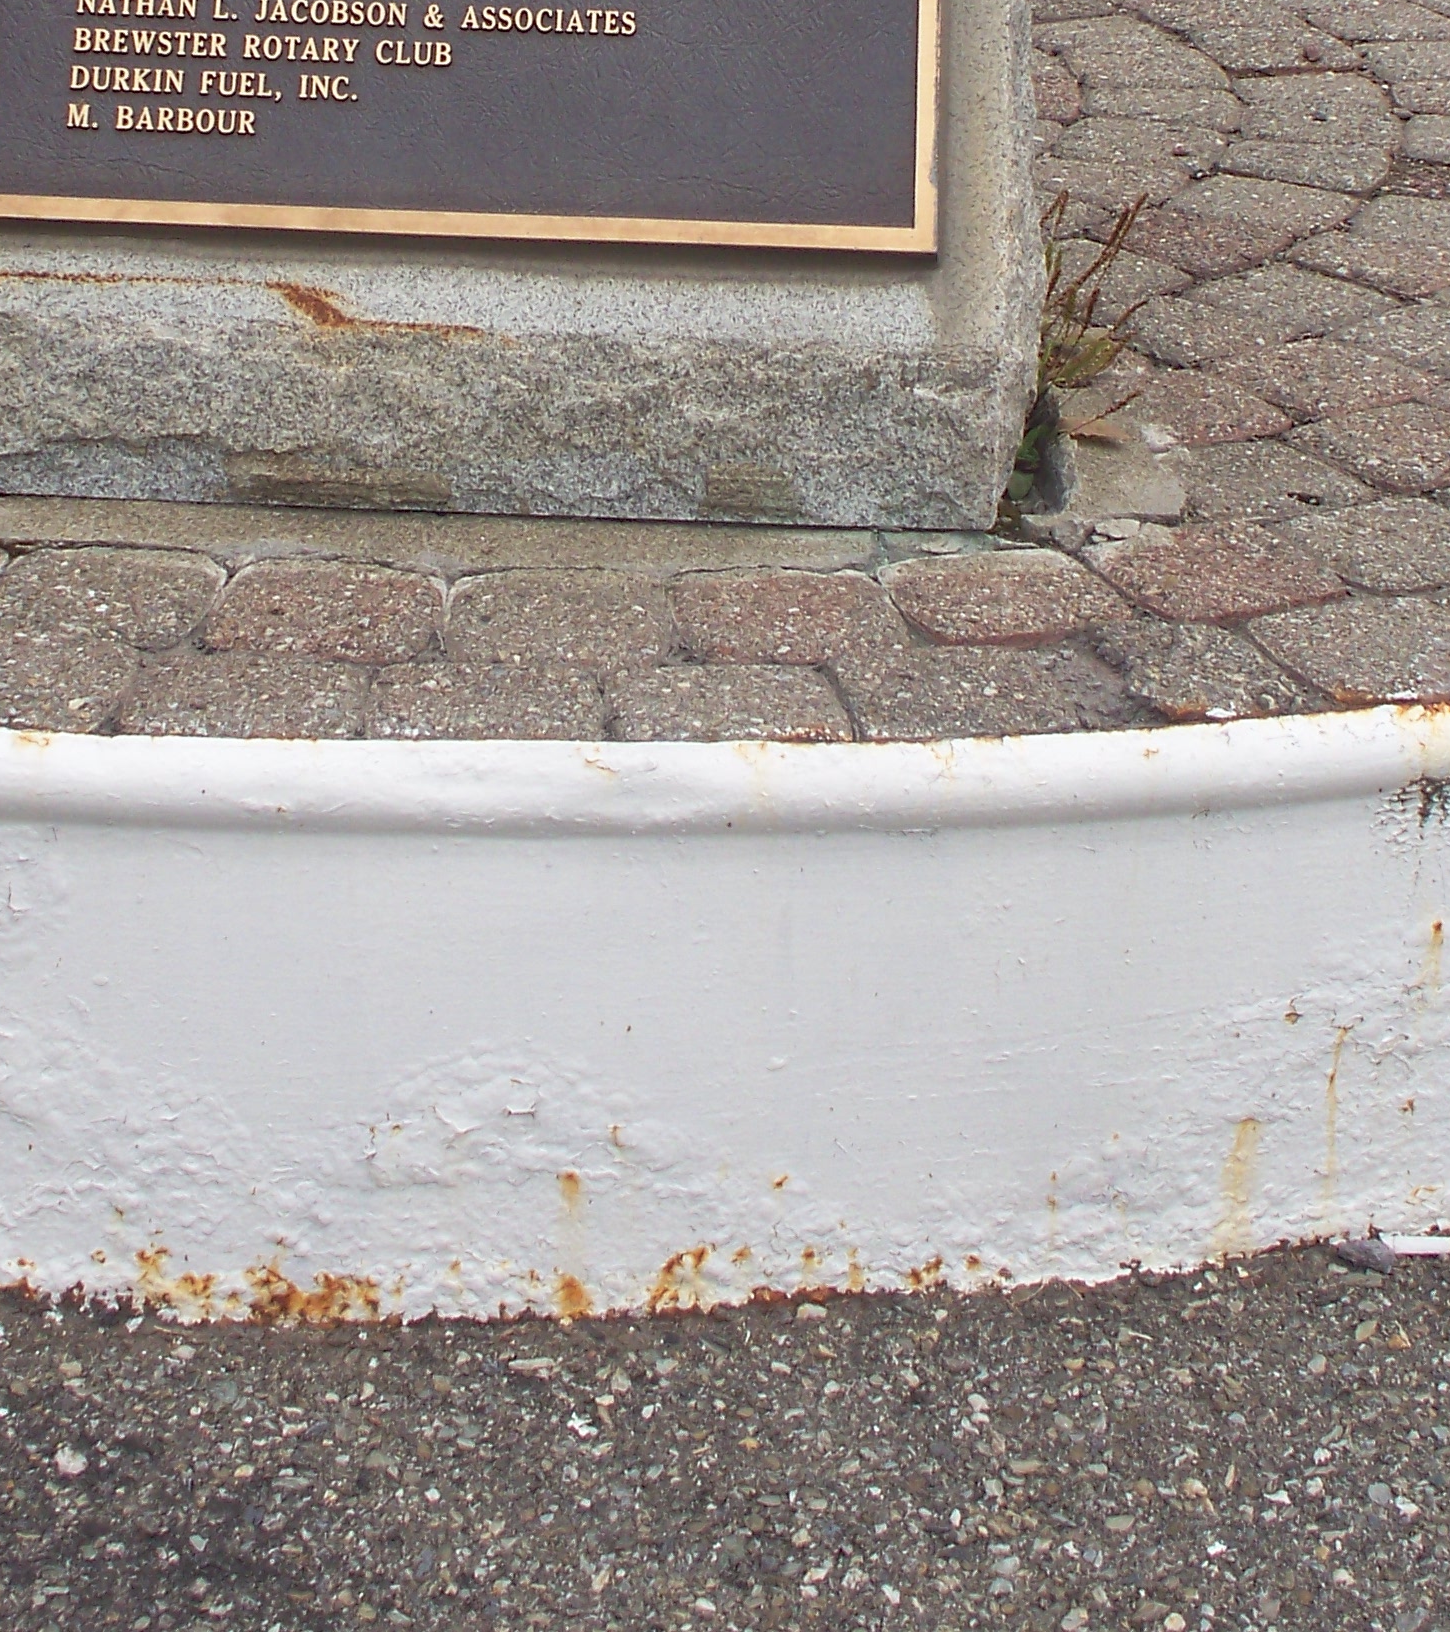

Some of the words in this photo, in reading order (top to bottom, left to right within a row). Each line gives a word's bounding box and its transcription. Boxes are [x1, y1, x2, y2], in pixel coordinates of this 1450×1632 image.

[422, 2, 445, 29] &
[459, 4, 637, 36] ASSOCIATES
[72, 26, 228, 58] BREWSTER
[241, 33, 361, 63] ROTARY
[374, 38, 453, 67] CLUB
[68, 64, 186, 94] DURKIN
[198, 69, 283, 102] FUEL,
[297, 73, 359, 101] INC.
[65, 101, 99, 129] M.
[114, 104, 256, 135] BARBOUR
